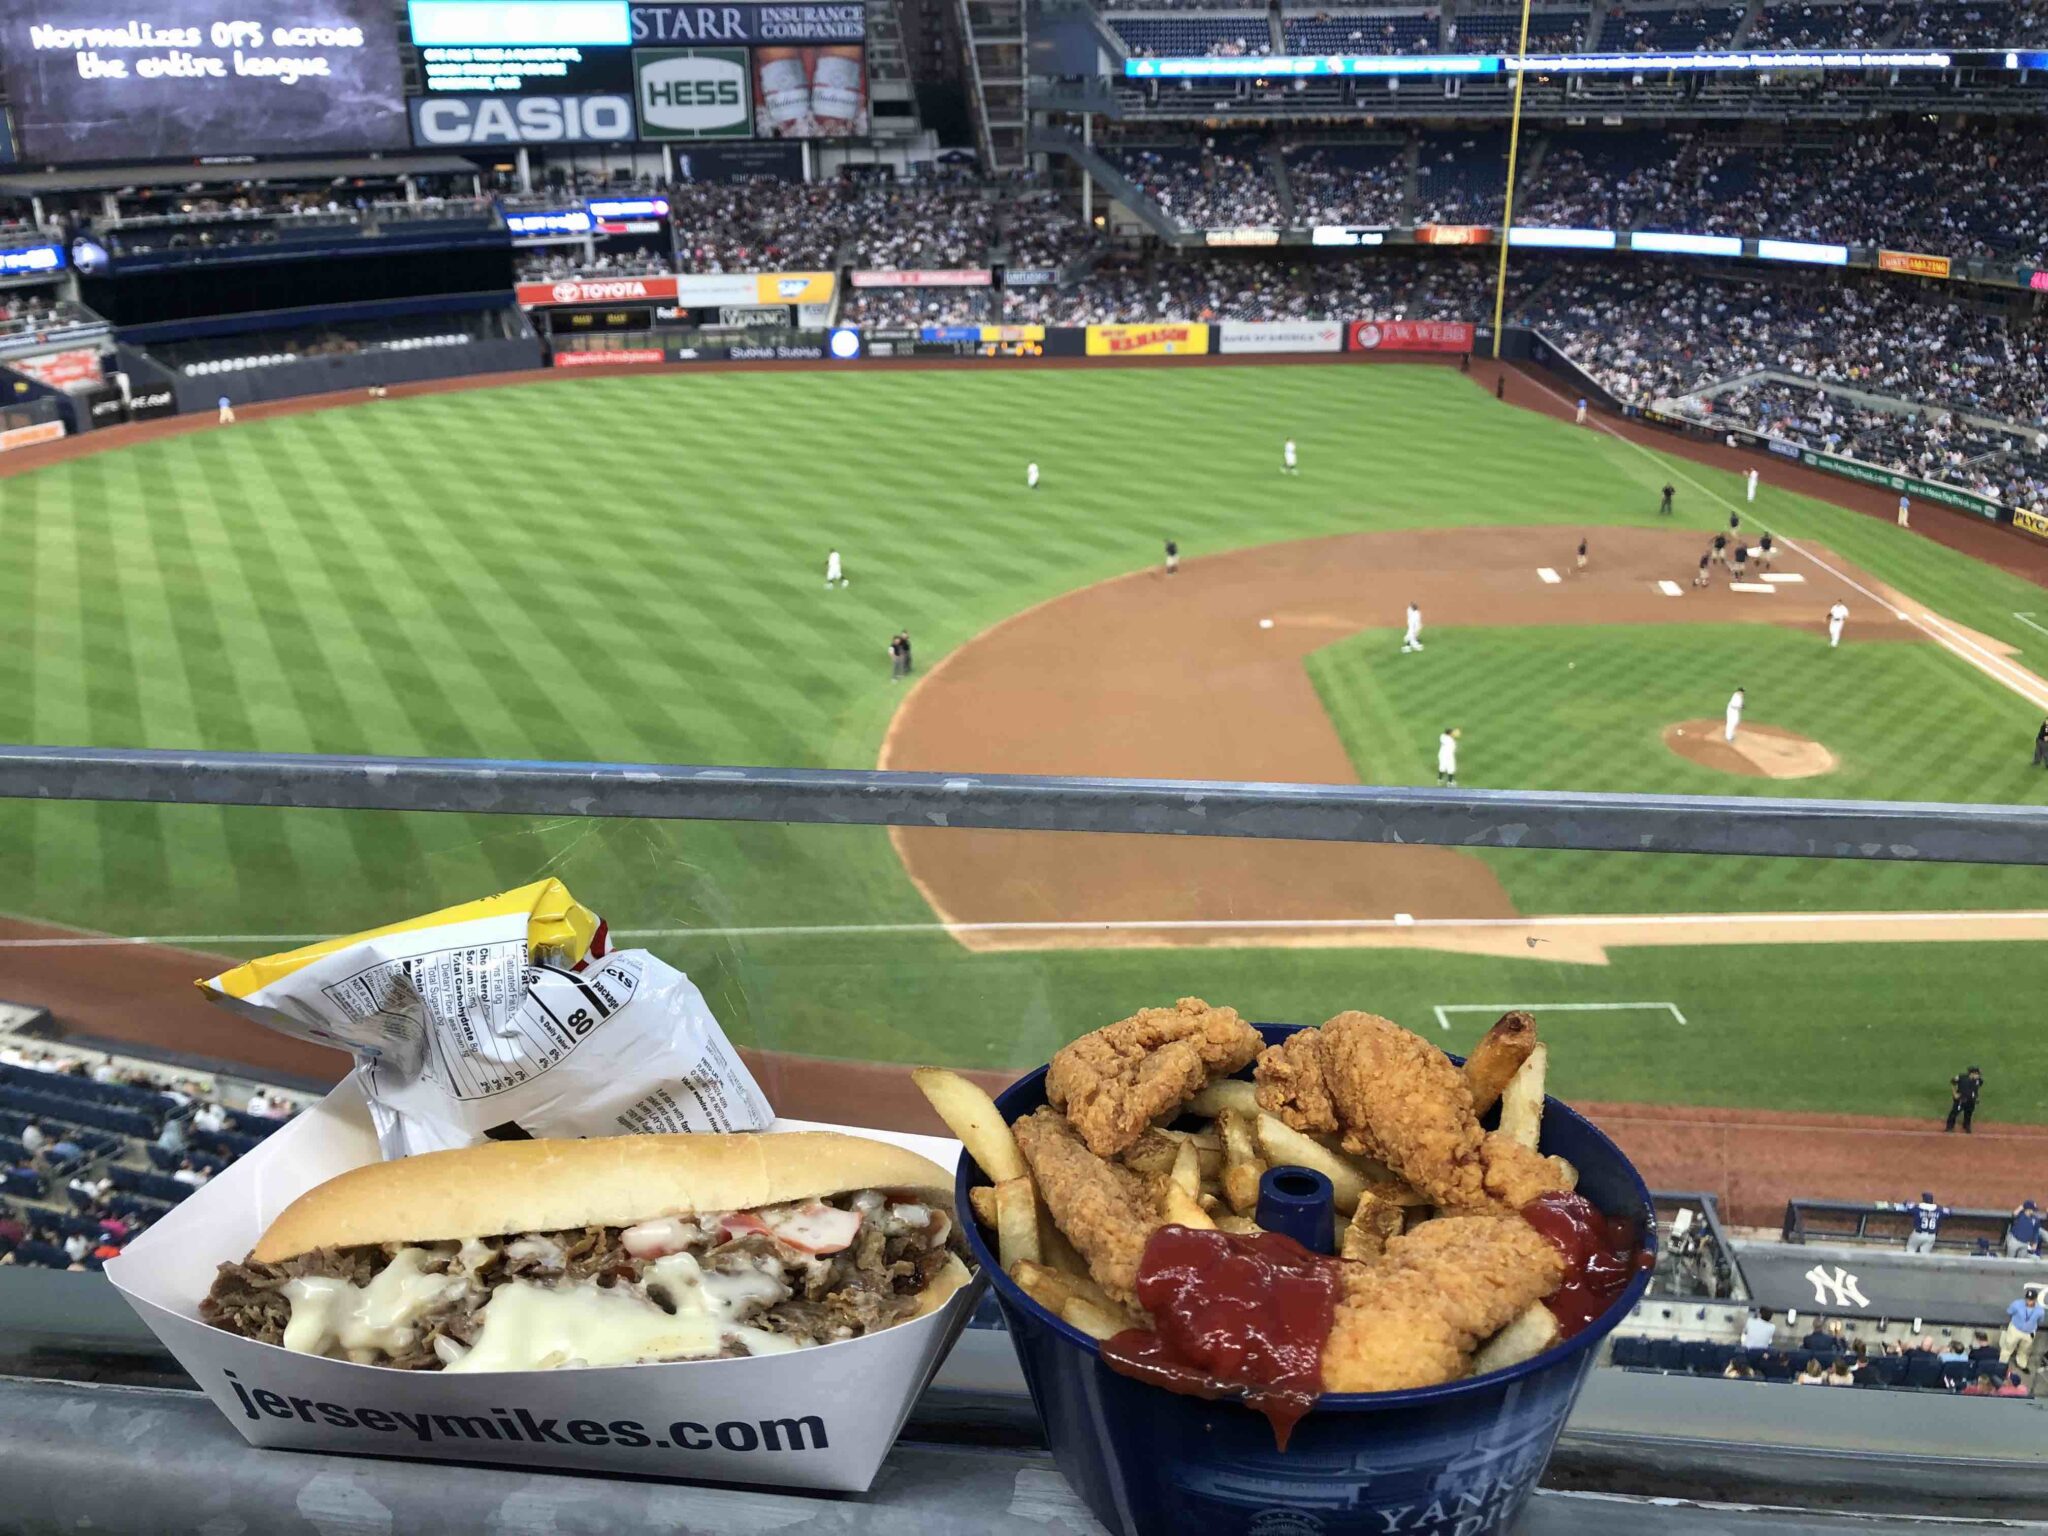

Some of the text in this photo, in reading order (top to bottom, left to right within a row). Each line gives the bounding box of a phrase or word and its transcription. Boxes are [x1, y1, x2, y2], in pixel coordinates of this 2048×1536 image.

[630, 8, 749, 40] STARR
[760, 6, 865, 23] INSURANCE
[30, 24, 201, 50] Normalizes
[272, 25, 364, 48] across
[760, 21, 865, 39] COMPANIES
[76, 51, 332, 85] the entire league
[649, 80, 739, 107] HESS
[419, 96, 631, 143] CASIO
[580, 281, 647, 299] TOYOTA
[1415, 324, 1466, 341] WEBB
[453, 951, 462, 976] Total
[350, 979, 362, 992] Not
[441, 963, 451, 992] Dietary
[480, 948, 490, 1003] Choesterol
[521, 969, 529, 985] Fat
[602, 967, 633, 989] cts
[428, 965, 445, 1026] Total Sugars 0g
[467, 987, 477, 1008] 85mg
[493, 979, 504, 1005] Fat 0g
[592, 981, 619, 1010] package
[445, 994, 453, 1014] Fiber
[455, 978, 475, 1041] Carbohydrate
[448, 1016, 457, 1031] less
[543, 1022, 557, 1037] Daily
[568, 1008, 594, 1036] 80
[539, 1058, 549, 1069] 4%
[549, 1048, 560, 1061] 6%
[515, 1070, 526, 1081] 0%
[694, 1091, 708, 1112] website
[664, 1115, 678, 1133] seaso
[673, 1106, 684, 1121] with
[1921, 1216, 1937, 1230] 36
[1805, 1264, 1871, 1308] NY
[223, 1370, 829, 1451] jerseymikes.com
